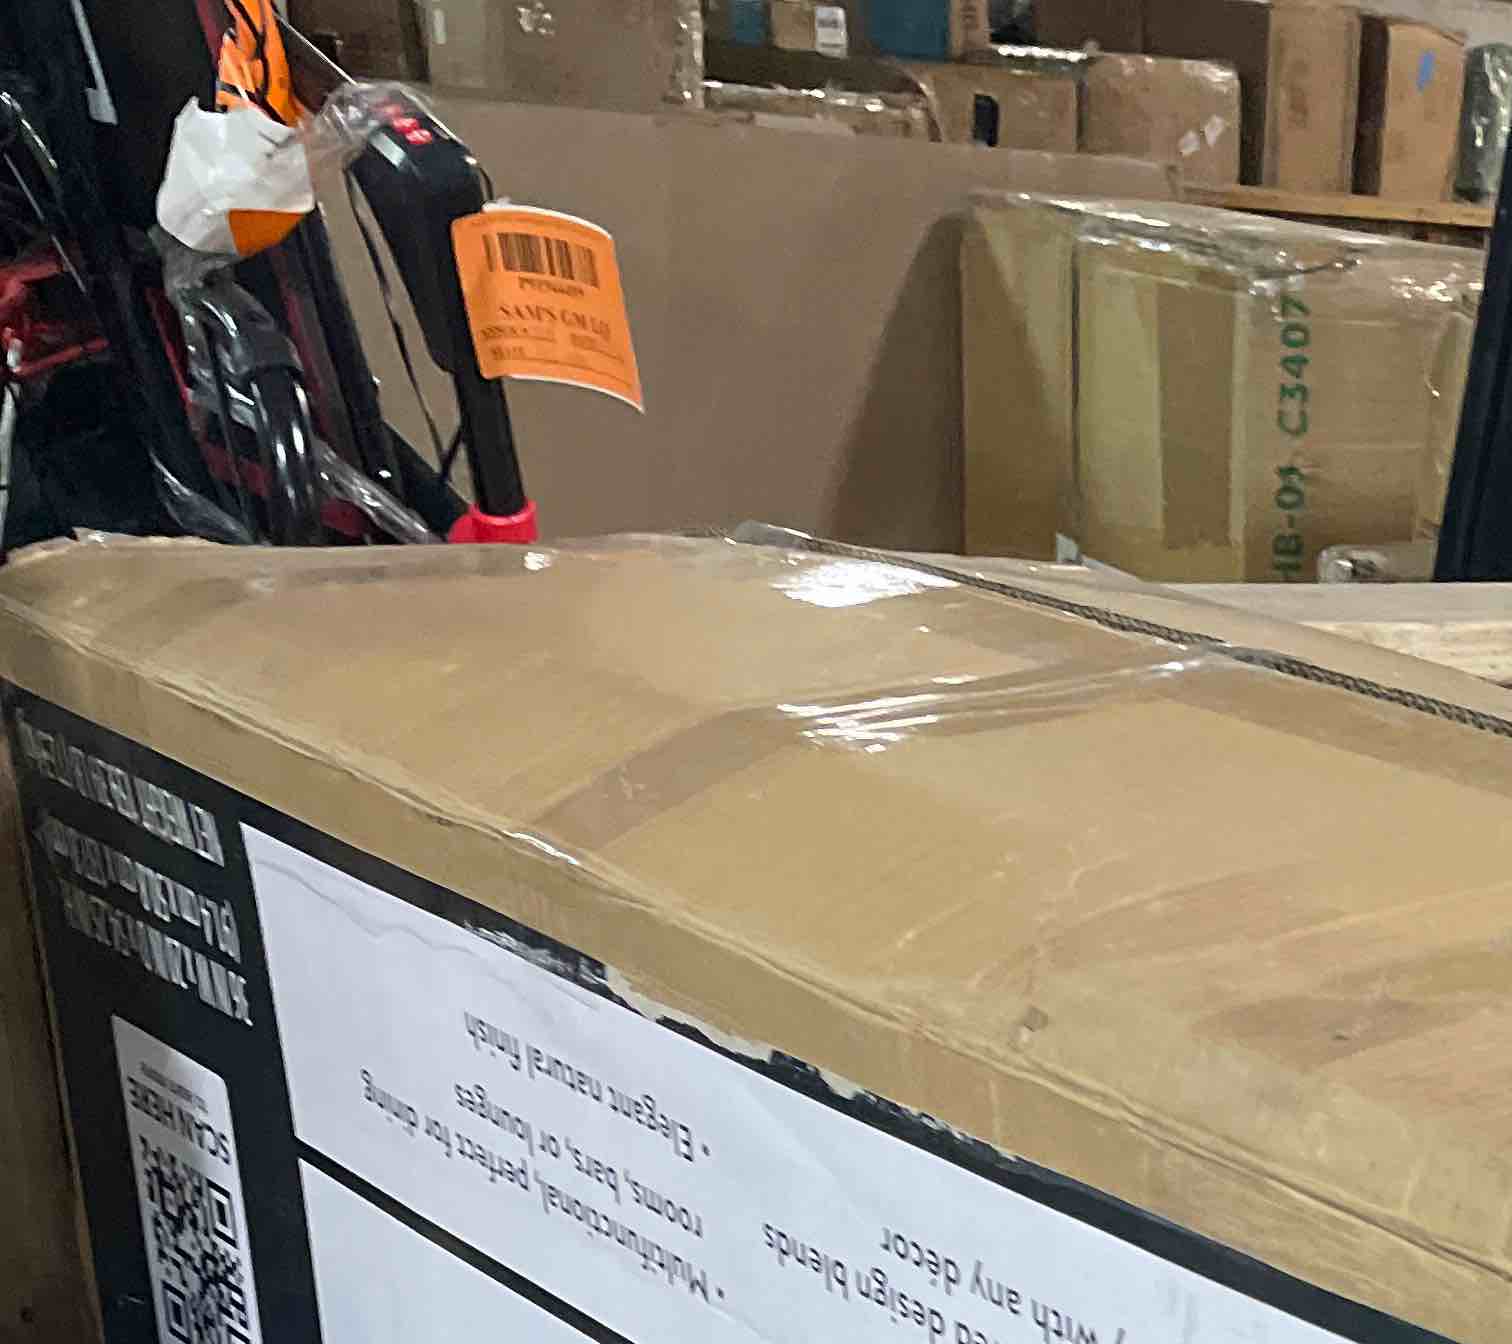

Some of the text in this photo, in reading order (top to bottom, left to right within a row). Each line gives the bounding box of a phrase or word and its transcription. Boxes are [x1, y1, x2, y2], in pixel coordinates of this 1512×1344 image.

[1277, 296, 1311, 436] C3407
[127, 1076, 176, 1132] HERE
[359, 1069, 417, 1141] dining
[462, 1009, 693, 1162] Elegant natural finish
[177, 1106, 230, 1165] SCAN
[425, 1110, 454, 1153] for
[455, 1083, 705, 1238] rooms, bars, or lounges
[455, 1131, 529, 1193] perfect
[762, 1221, 849, 1293] blends
[878, 1227, 963, 1297] décor
[971, 1257, 1021, 1314] any
